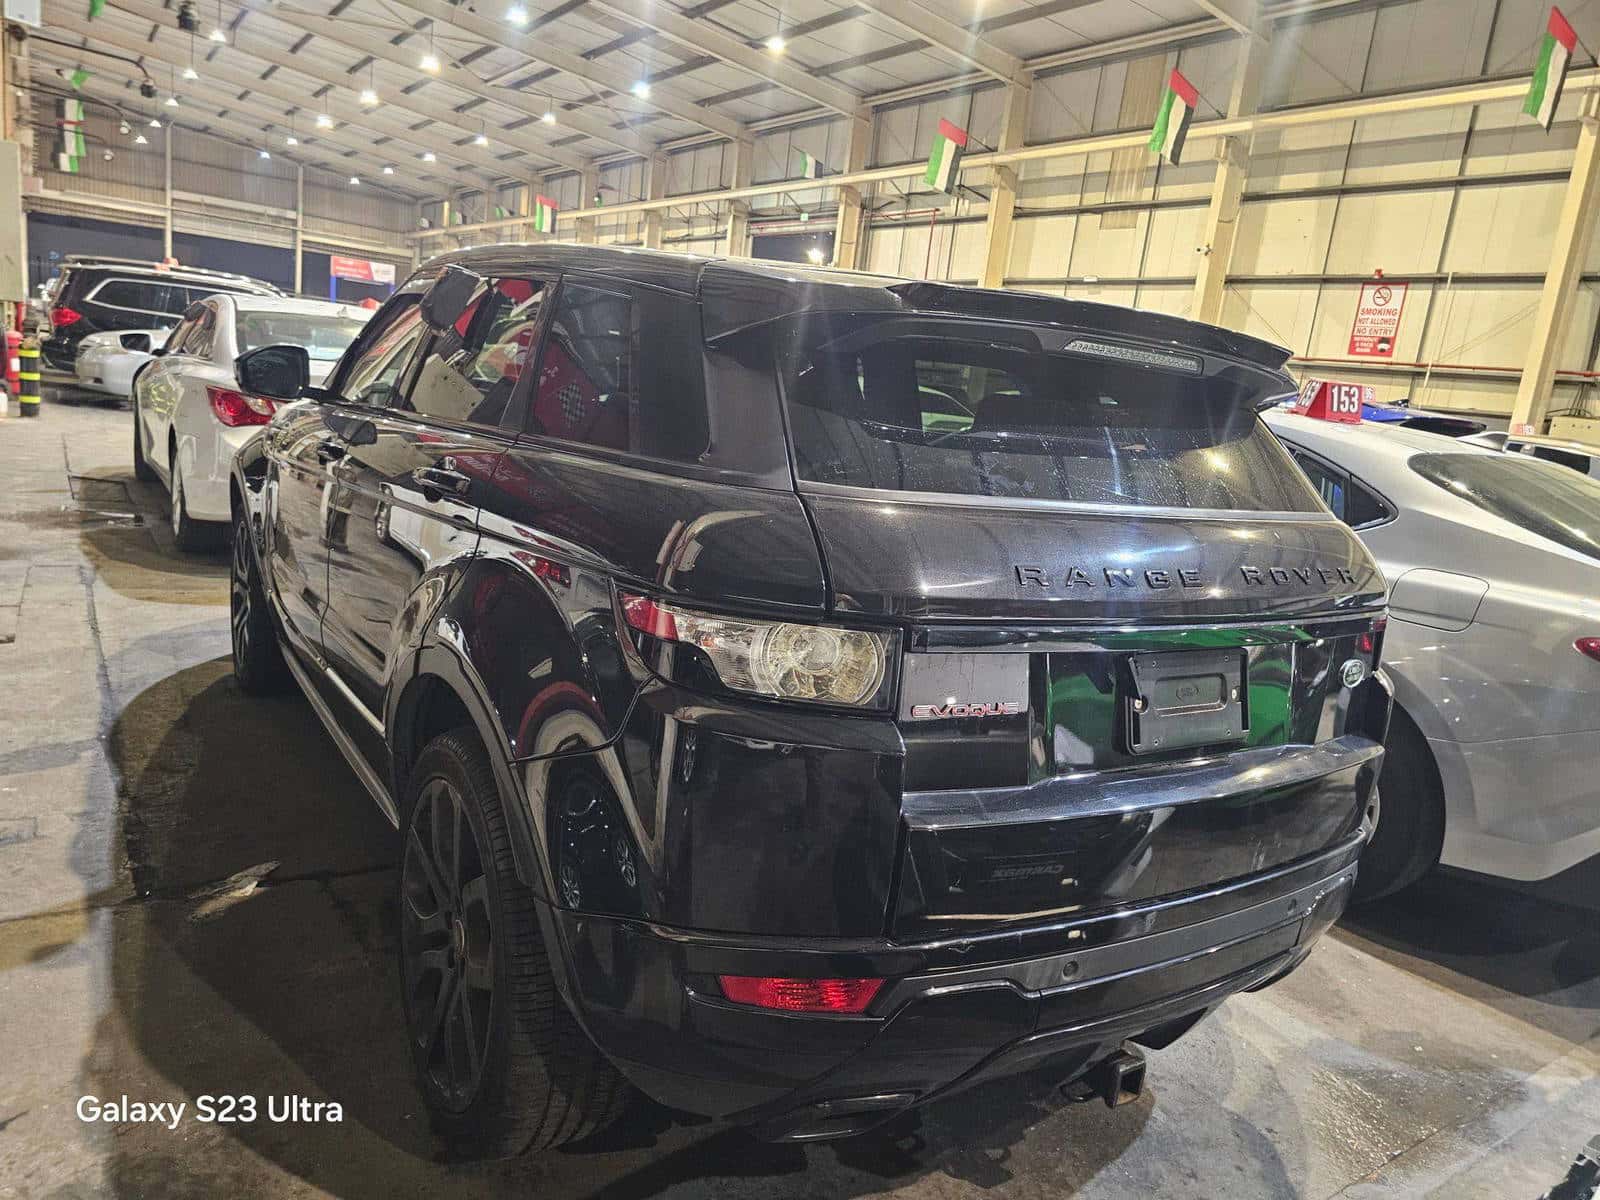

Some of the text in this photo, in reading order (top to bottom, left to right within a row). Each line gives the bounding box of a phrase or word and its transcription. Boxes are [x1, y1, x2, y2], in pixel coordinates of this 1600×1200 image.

[1360, 307, 1398, 316] SMOKING
[1368, 327, 1393, 335] ENTRY
[1331, 385, 1359, 413] 153
[1014, 564, 1356, 589] RANGE ROVER
[911, 702, 1019, 718] EVOQUE
